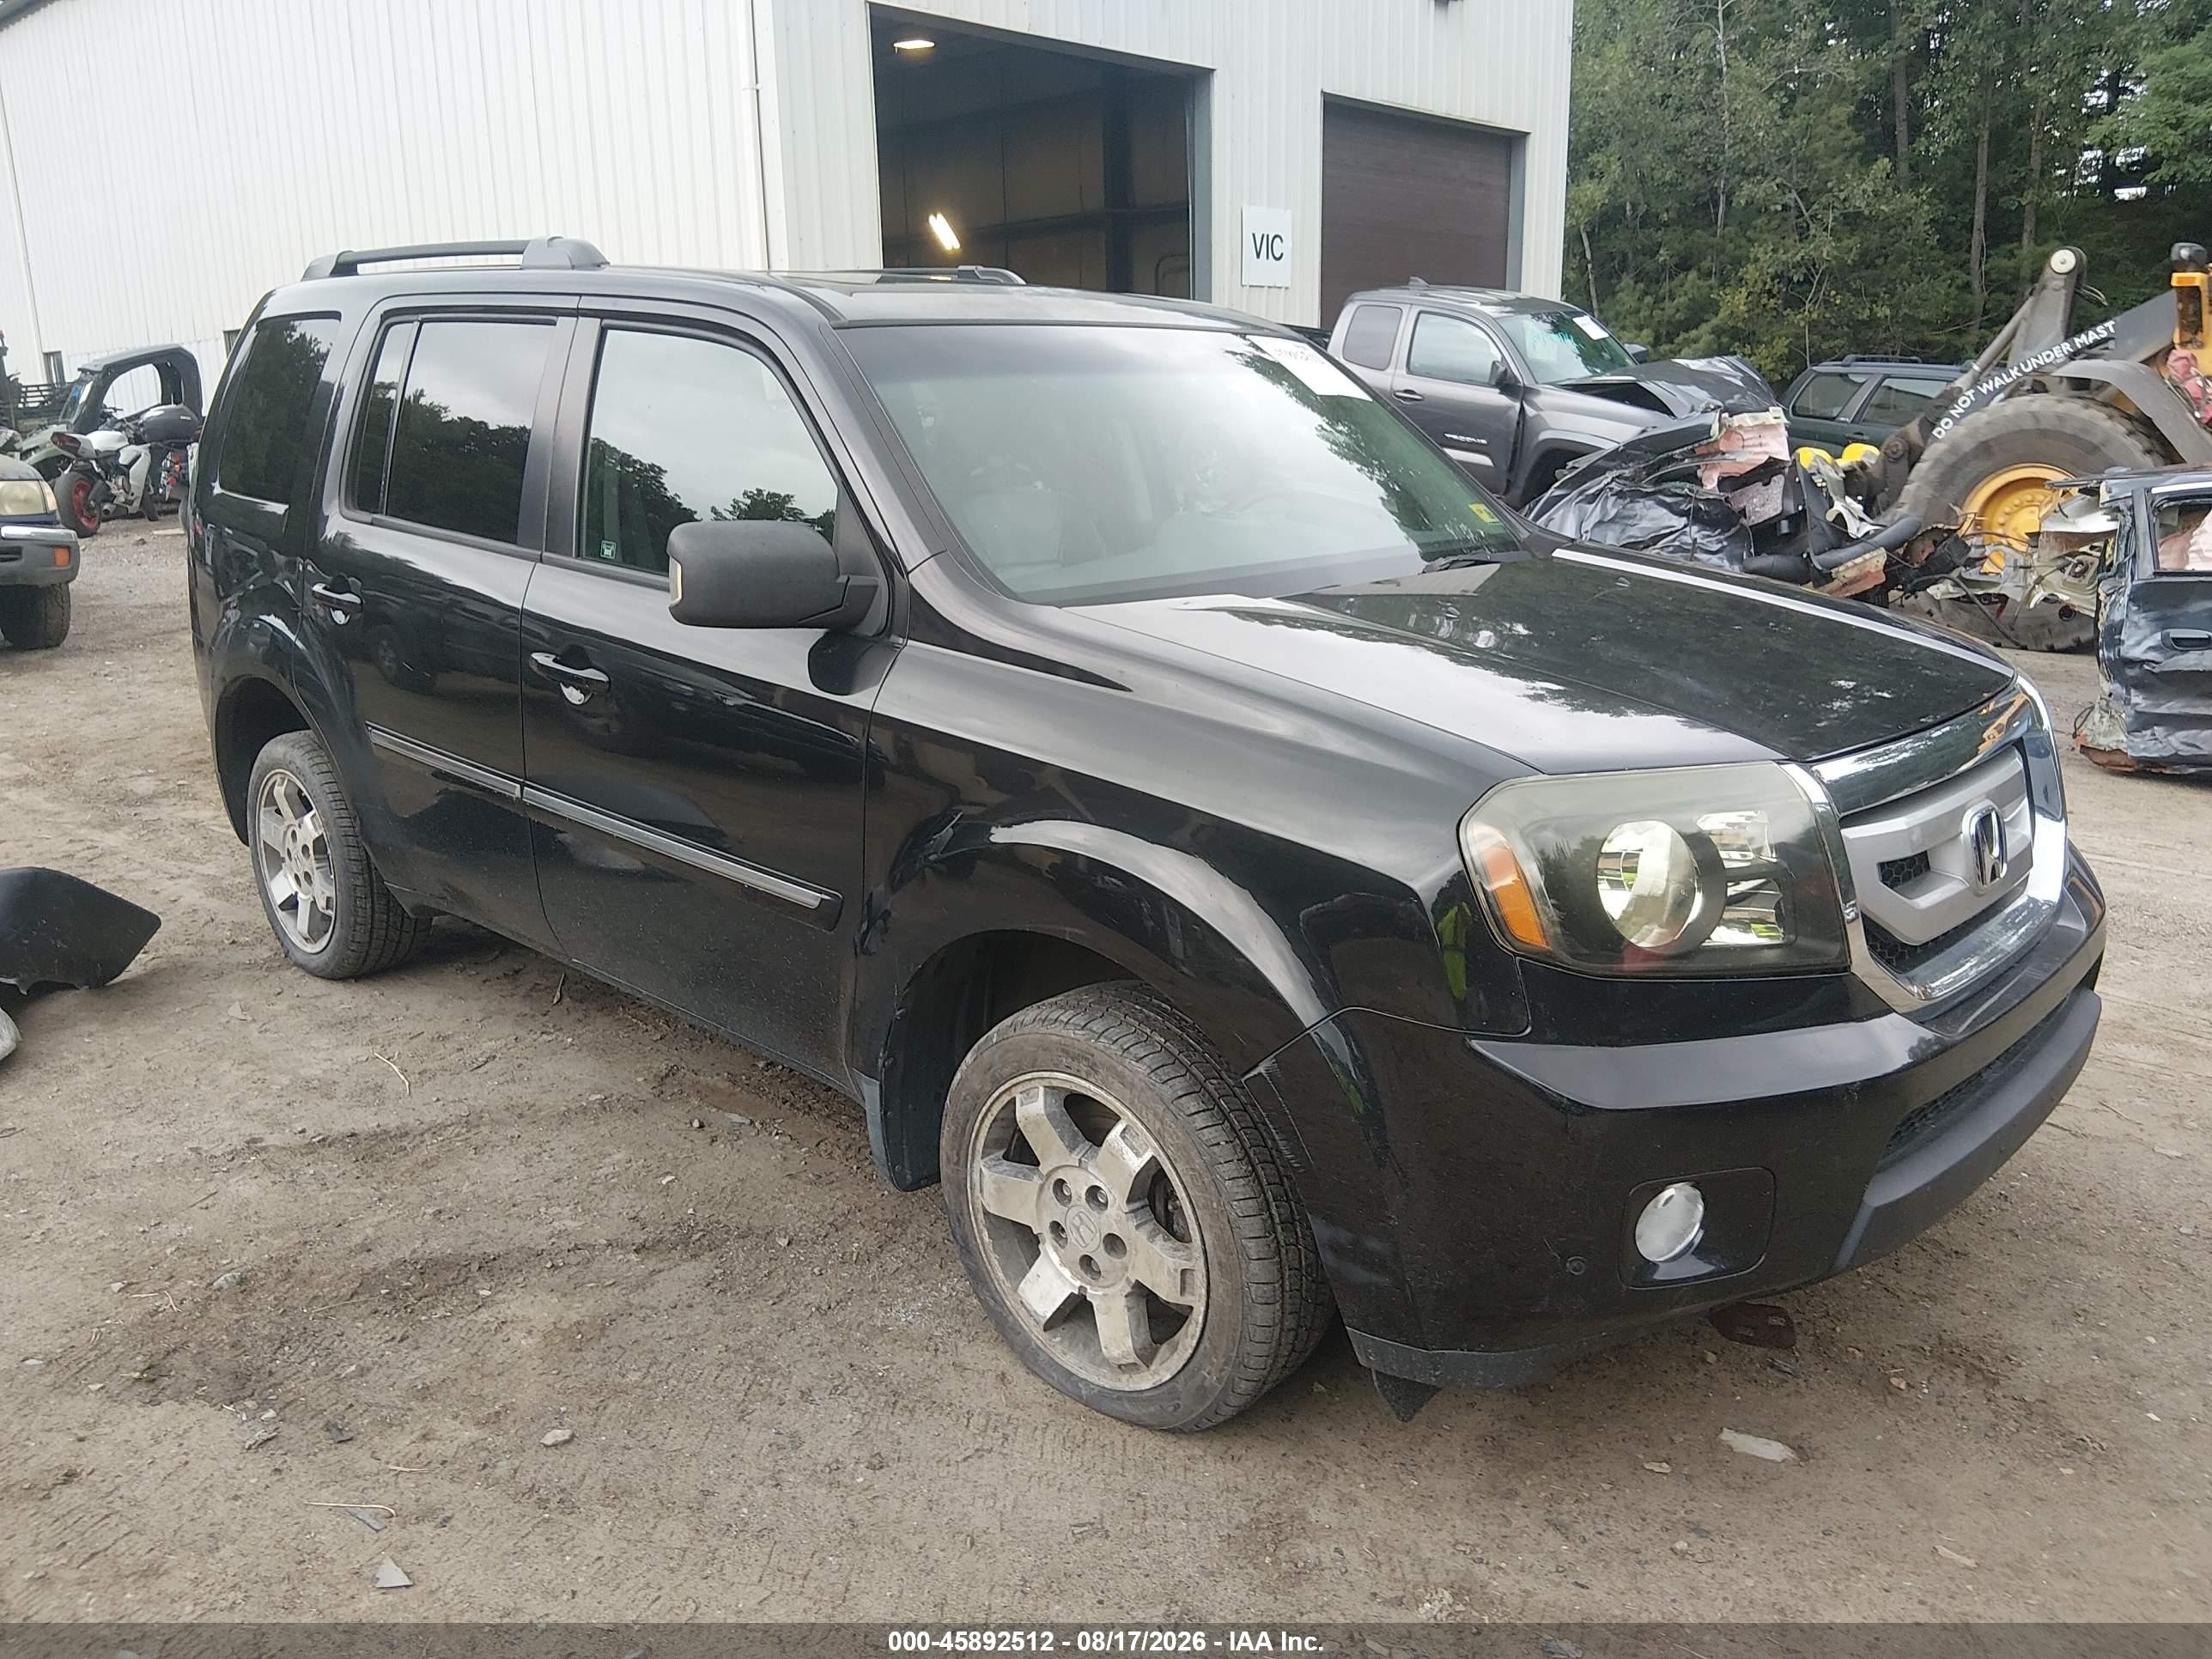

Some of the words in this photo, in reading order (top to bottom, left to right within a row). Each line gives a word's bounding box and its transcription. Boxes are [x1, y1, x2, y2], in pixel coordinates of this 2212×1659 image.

[1252, 233, 1284, 261] VIC
[1932, 417, 1954, 440] DO
[1949, 389, 1976, 418] NOT
[1976, 367, 2022, 396] WALK
[2020, 342, 2074, 374] UNDER
[2073, 319, 2116, 349] MAST
